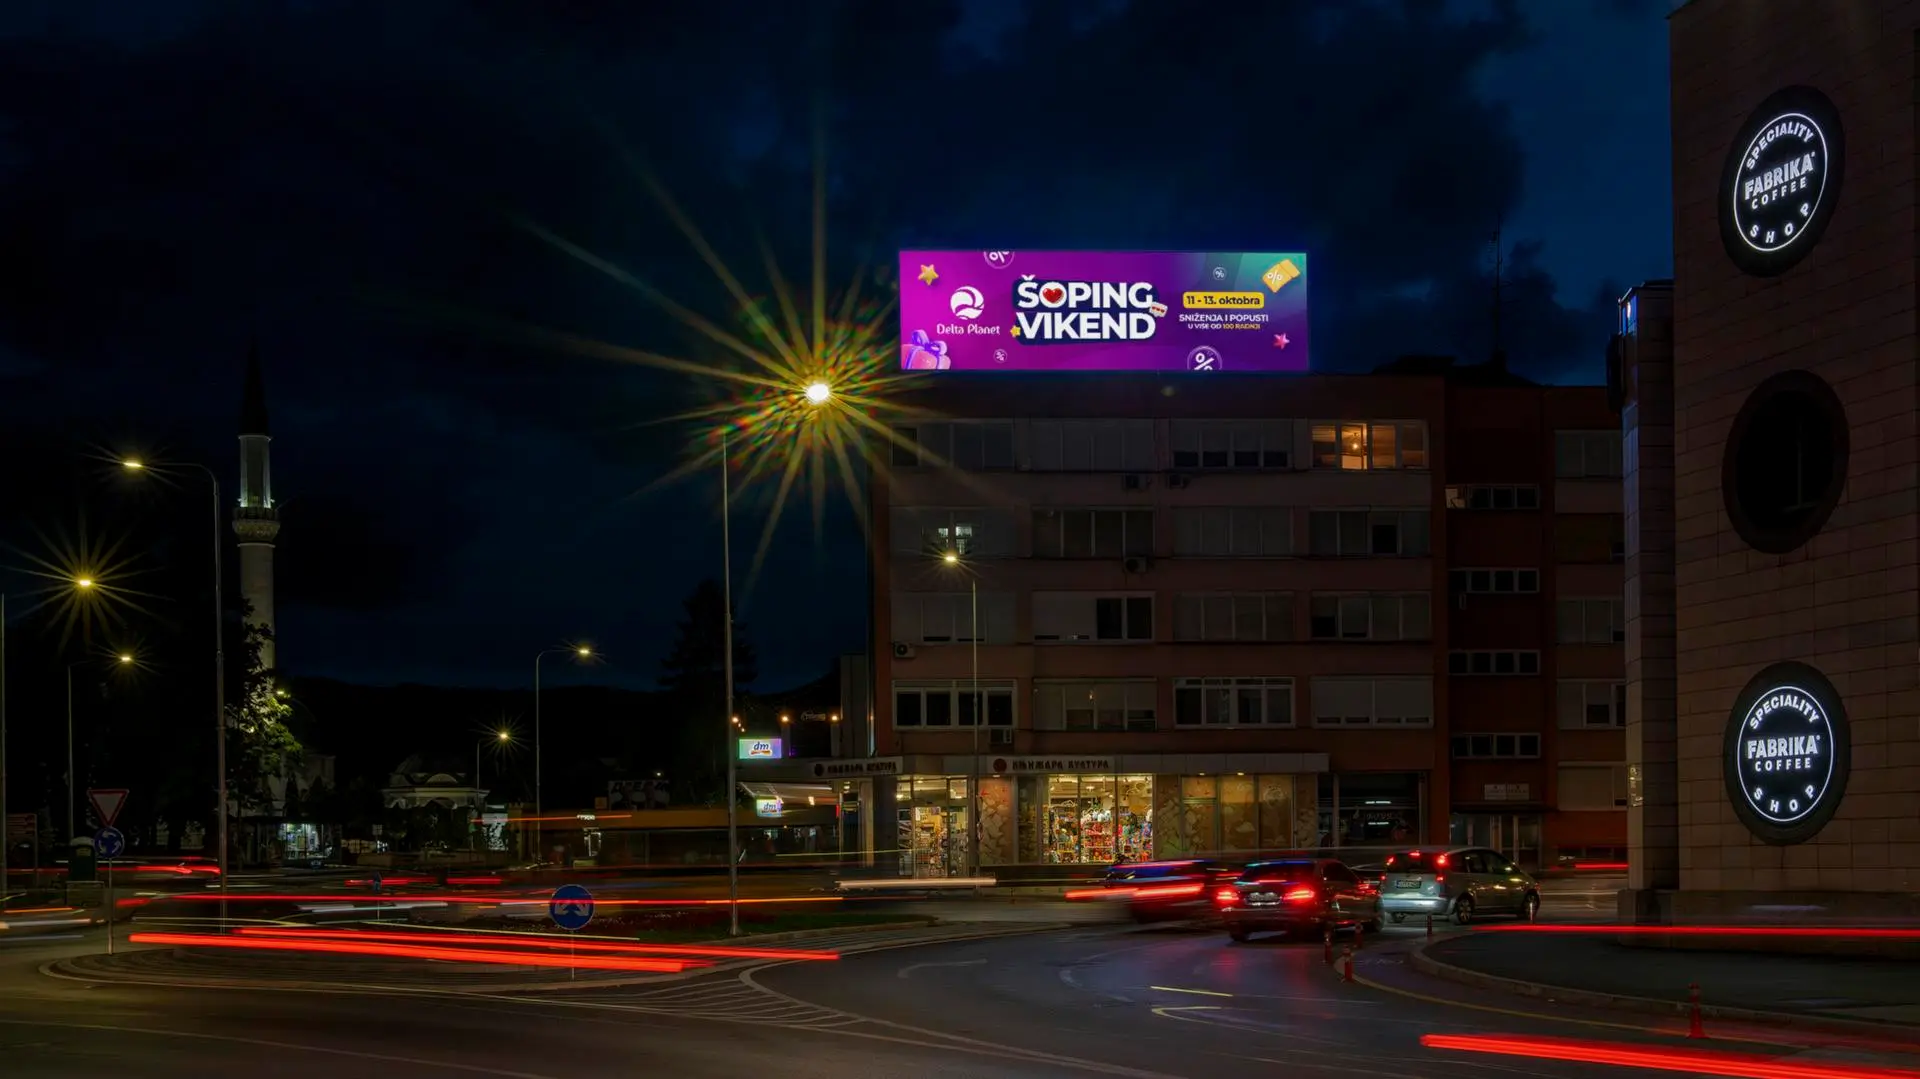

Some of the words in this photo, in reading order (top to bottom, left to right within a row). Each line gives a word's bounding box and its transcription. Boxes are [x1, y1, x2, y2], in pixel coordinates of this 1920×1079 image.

[1746, 121, 1814, 170] SPECIALITY
[1744, 151, 1816, 200] FABRIKA
[1751, 176, 1807, 210] COFFEE
[1750, 202, 1809, 243] SHOP
[1018, 274, 1154, 308] ŠOPING
[1186, 295, 1195, 305] 11
[1203, 295, 1217, 305] 13.
[1218, 295, 1261, 305] oktobra
[936, 323, 964, 335] Delta
[967, 323, 1000, 335] Planet
[1016, 311, 1156, 340] VIKEND
[1179, 312, 1223, 322] SNIŽENJA
[1229, 314, 1269, 322] POPUSTI
[1750, 694, 1819, 730] SPECIALITY
[753, 741, 770, 750] dm
[1747, 734, 1821, 760] FABRIKA
[1755, 757, 1811, 772] COFFEE
[1754, 784, 1815, 813] SHOP
